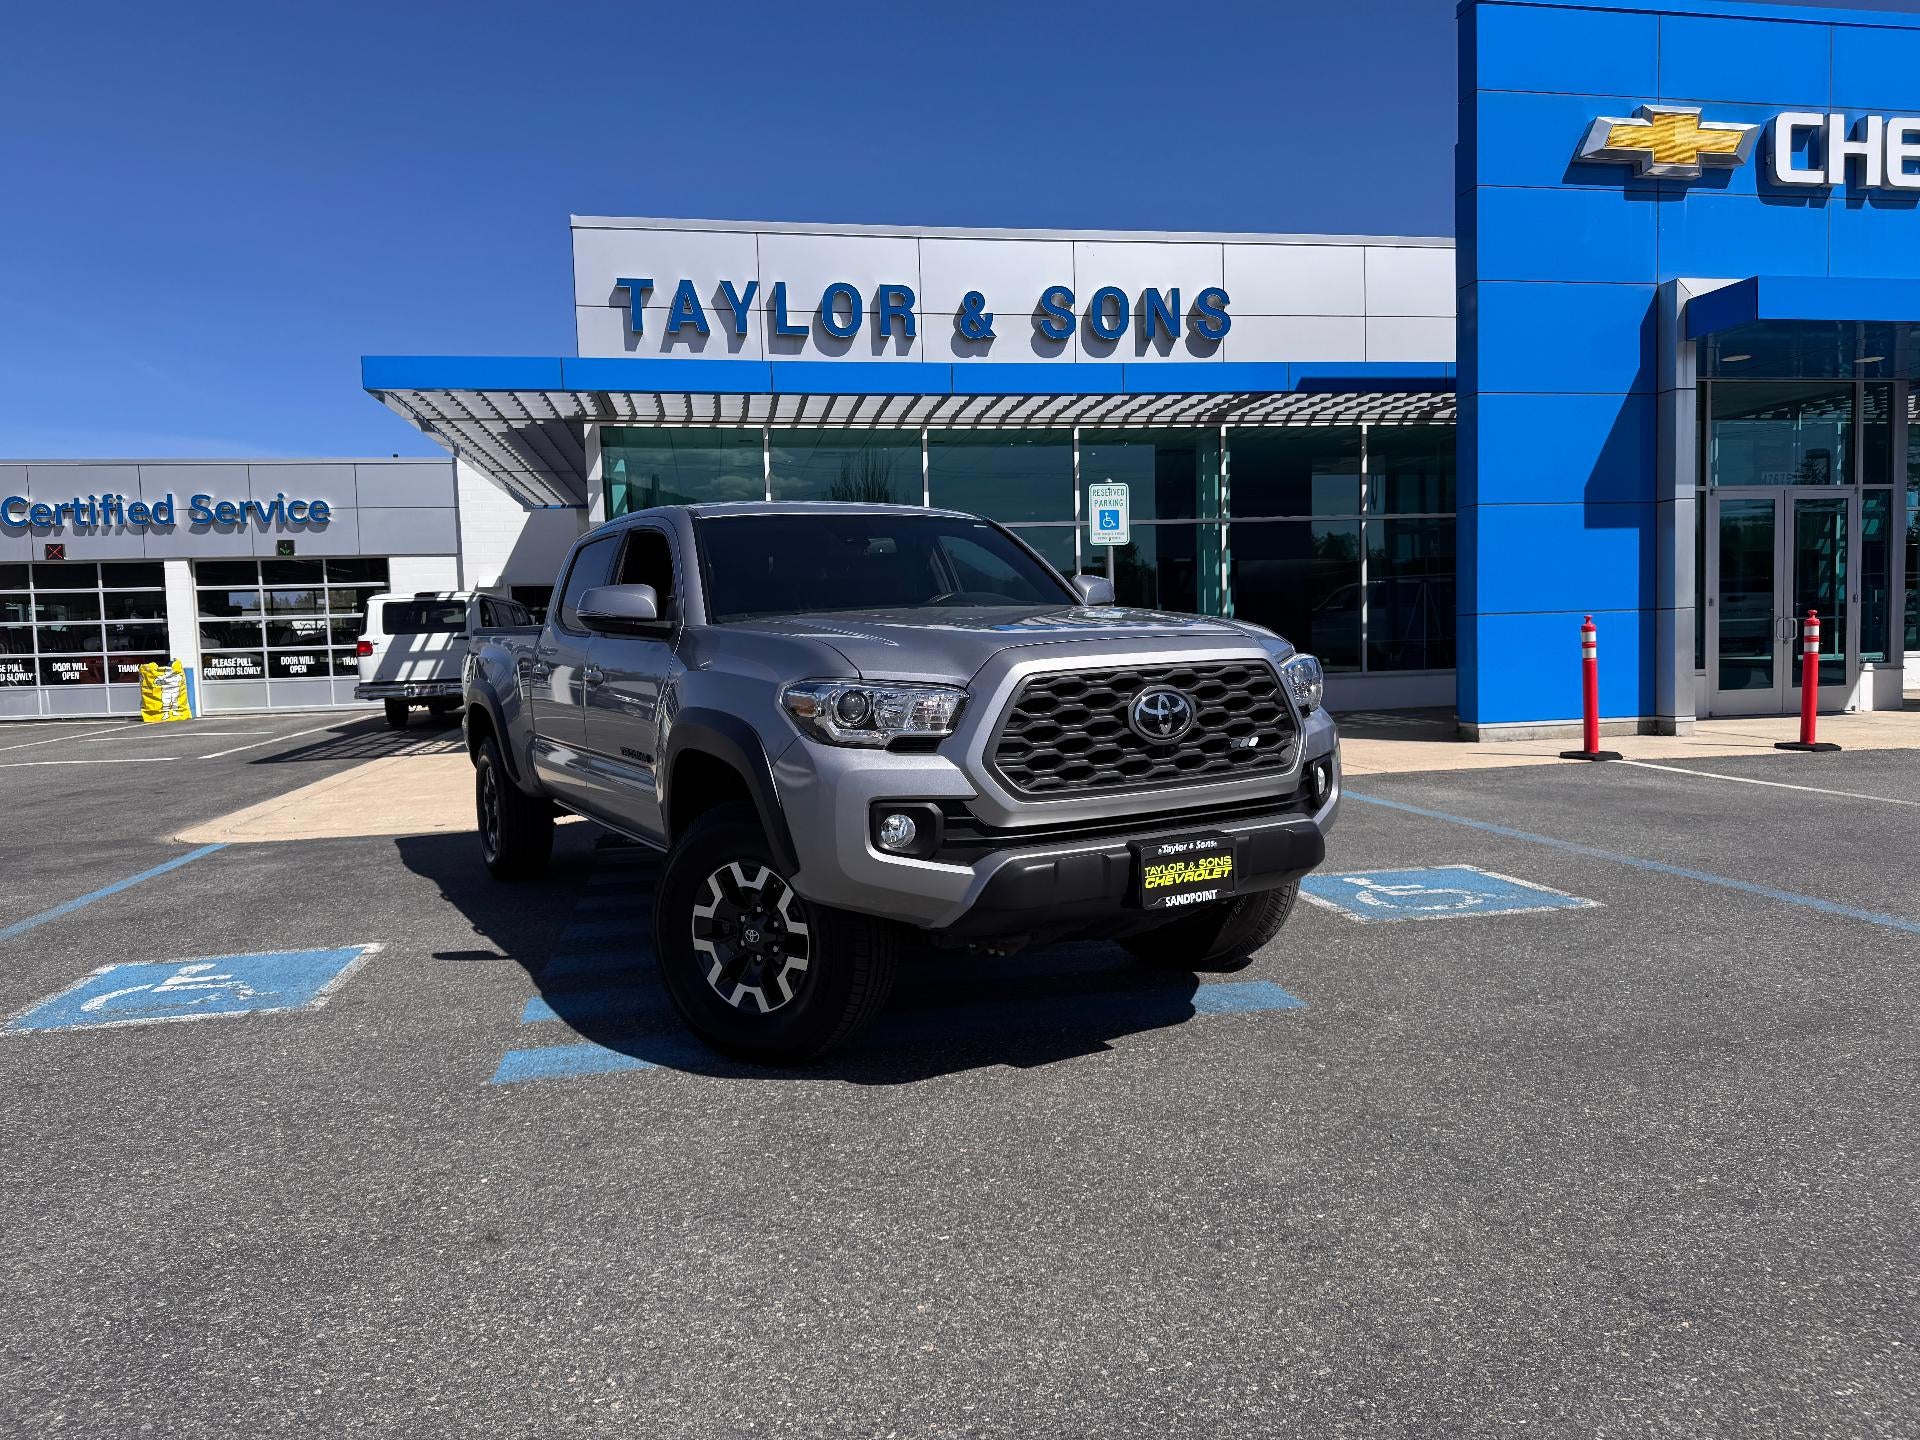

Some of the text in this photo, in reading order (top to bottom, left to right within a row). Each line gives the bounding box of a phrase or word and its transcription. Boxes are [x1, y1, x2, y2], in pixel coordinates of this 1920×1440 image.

[1775, 112, 1920, 187] CHE
[616, 277, 1231, 341] TAYLOR & SONS
[1092, 488, 1125, 497] RESERVED
[1094, 499, 1124, 507] PARKING
[1, 492, 331, 527] Certified Service
[212, 657, 253, 667] PLEASE PULL
[281, 656, 315, 665] DOOR WILL
[7, 663, 24, 673] PULL
[52, 662, 88, 672] DOOR WILL
[118, 664, 140, 673] THANK
[204, 666, 261, 676] FORWARD SLOWLY
[290, 664, 307, 674] OPEN
[6, 672, 33, 682] SLOWLY
[62, 671, 80, 681] OPEN
[1161, 843, 1187, 855] Taylor
[1195, 840, 1214, 849] Sons
[1144, 855, 1232, 876] TAYLOR & SONS
[1144, 866, 1232, 889] CHEVROLET
[1165, 889, 1218, 908] SANDPOINT
